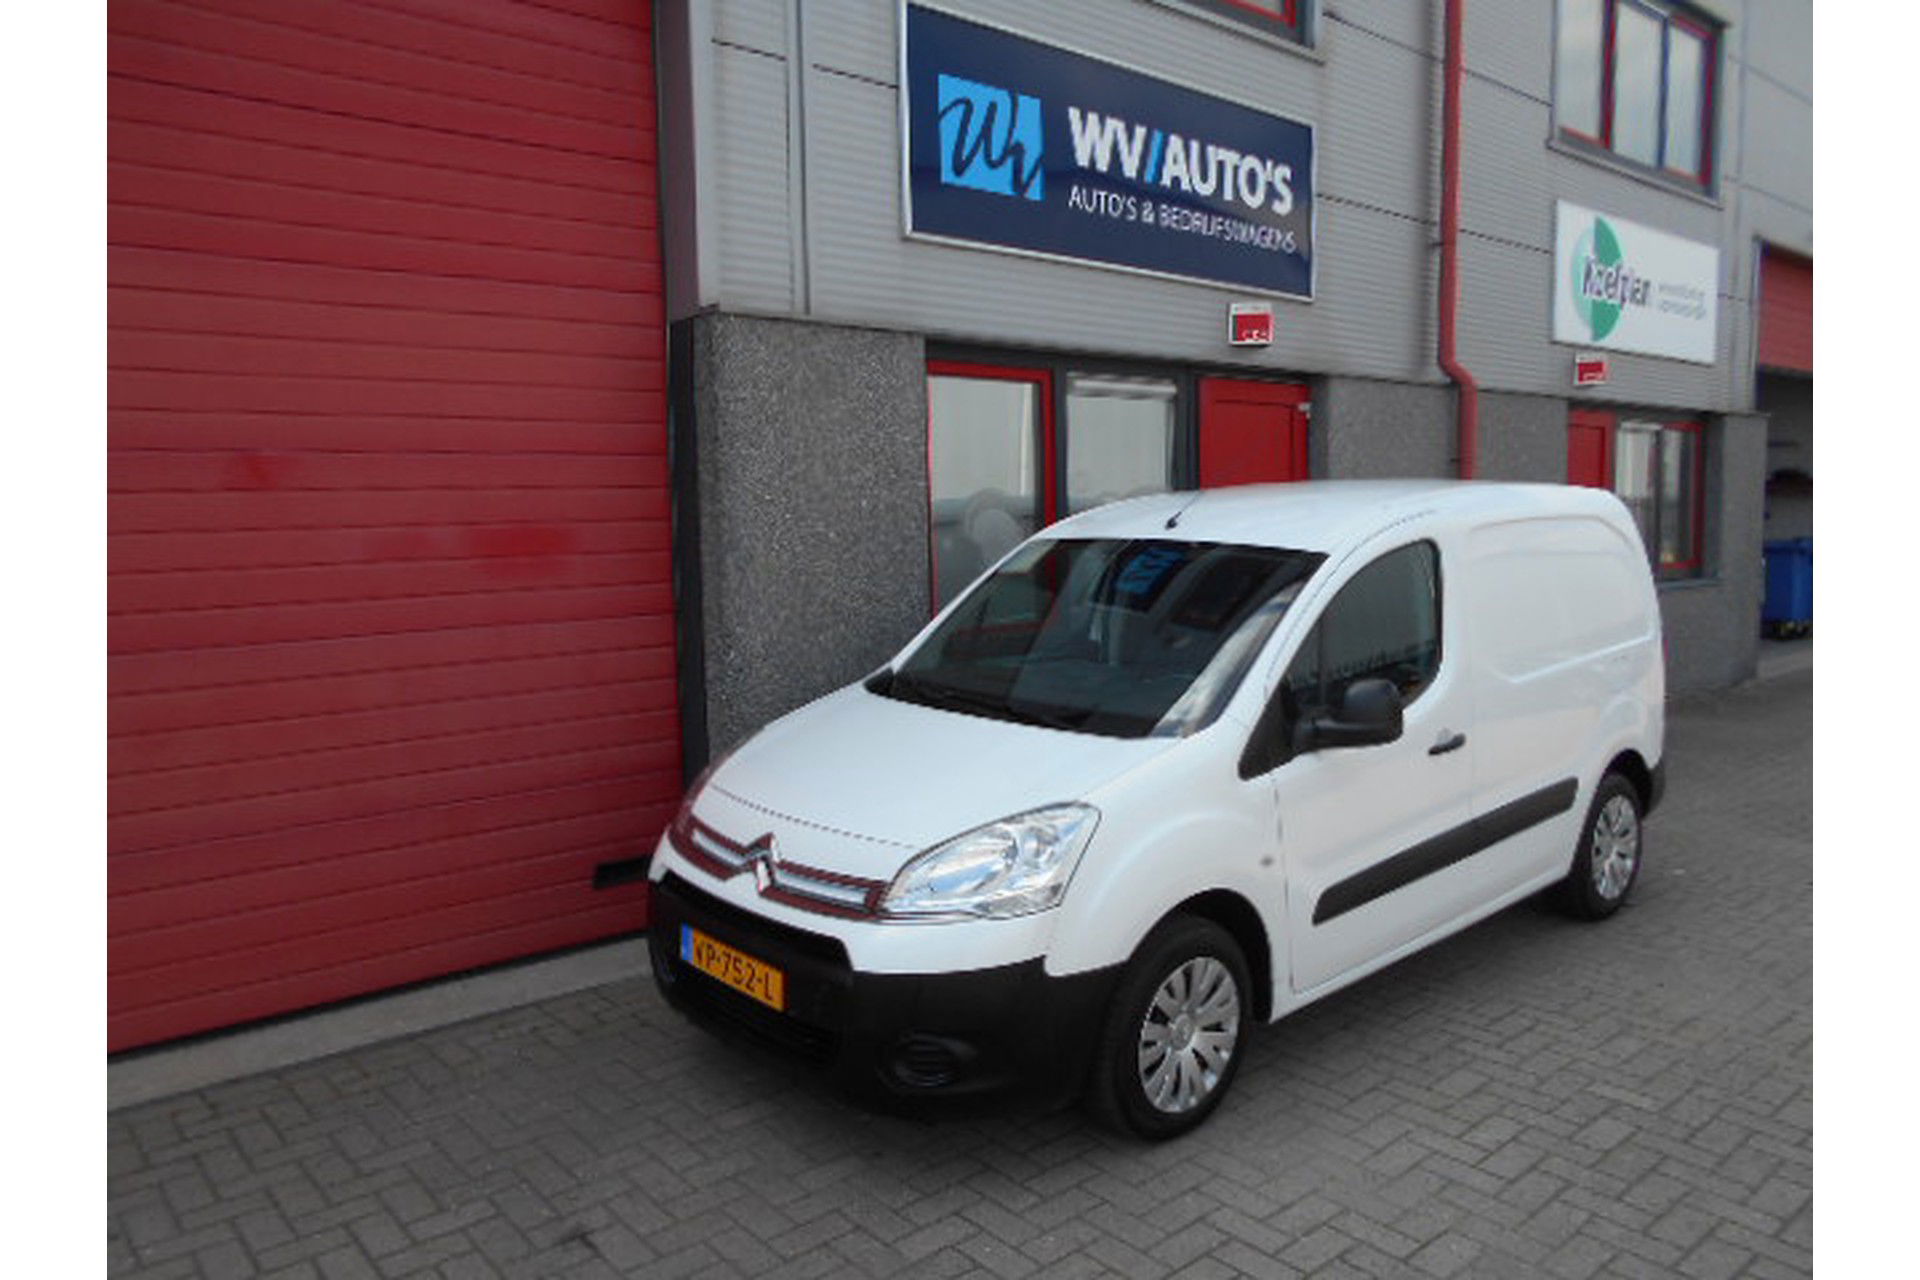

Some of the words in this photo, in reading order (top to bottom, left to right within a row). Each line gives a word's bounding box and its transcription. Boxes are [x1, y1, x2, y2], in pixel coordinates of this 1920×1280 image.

[1068, 185, 1137, 221] AUTO'S
[1141, 200, 1155, 223] &
[696, 940, 775, 1001] VP-752-L
